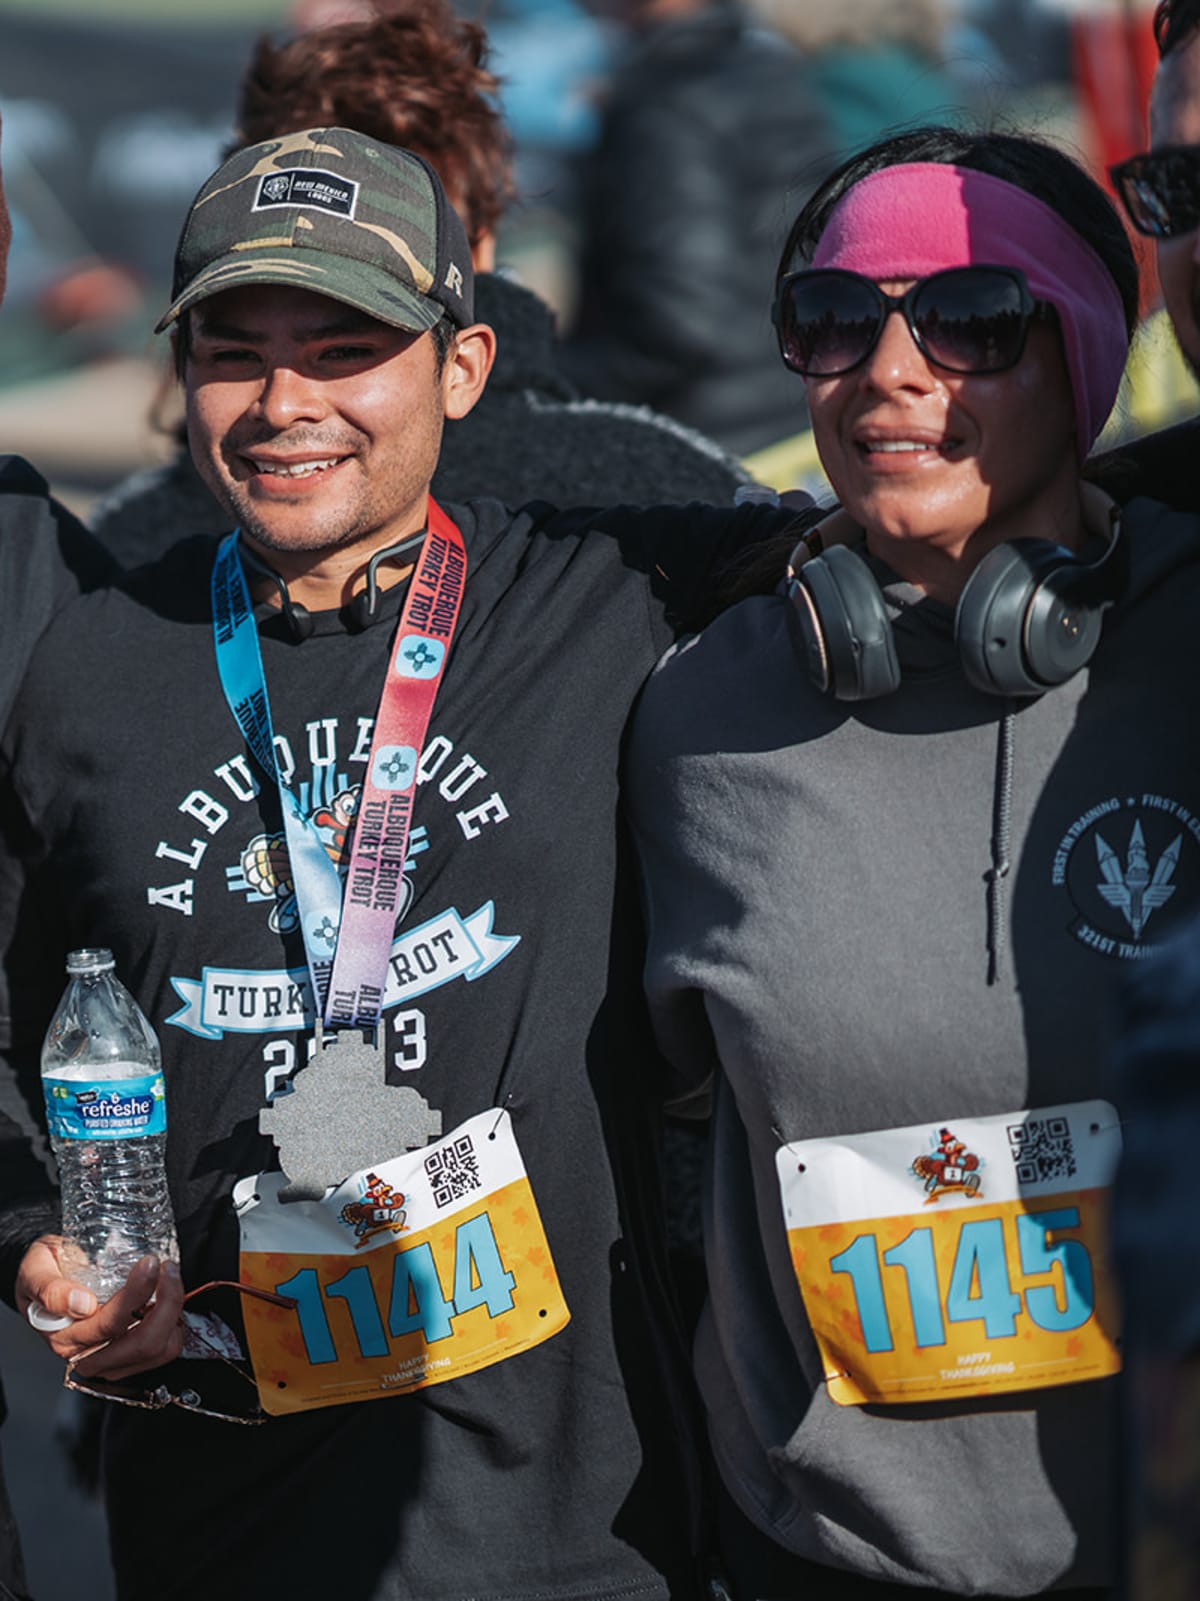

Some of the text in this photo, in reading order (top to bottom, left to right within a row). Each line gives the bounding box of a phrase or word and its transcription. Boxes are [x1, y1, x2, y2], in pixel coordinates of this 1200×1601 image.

[444, 262, 462, 298] R
[407, 533, 447, 631] TURKEY TROT
[429, 540, 464, 637] ALBUQUERQUE
[147, 717, 510, 916] ALBUQUEQUE
[1141, 793, 1178, 814] FIRST
[350, 800, 386, 908] TURKEY TROT
[373, 794, 410, 912] ALBUQUERQUE
[213, 983, 309, 1018] TURK
[382, 930, 459, 993] ROT
[82, 1097, 150, 1117] refreshe
[275, 1210, 517, 1366] 1144
[830, 1207, 1096, 1354] 1145
[399, 1353, 430, 1370] HAPPY
[956, 1352, 992, 1366] HAPPY
